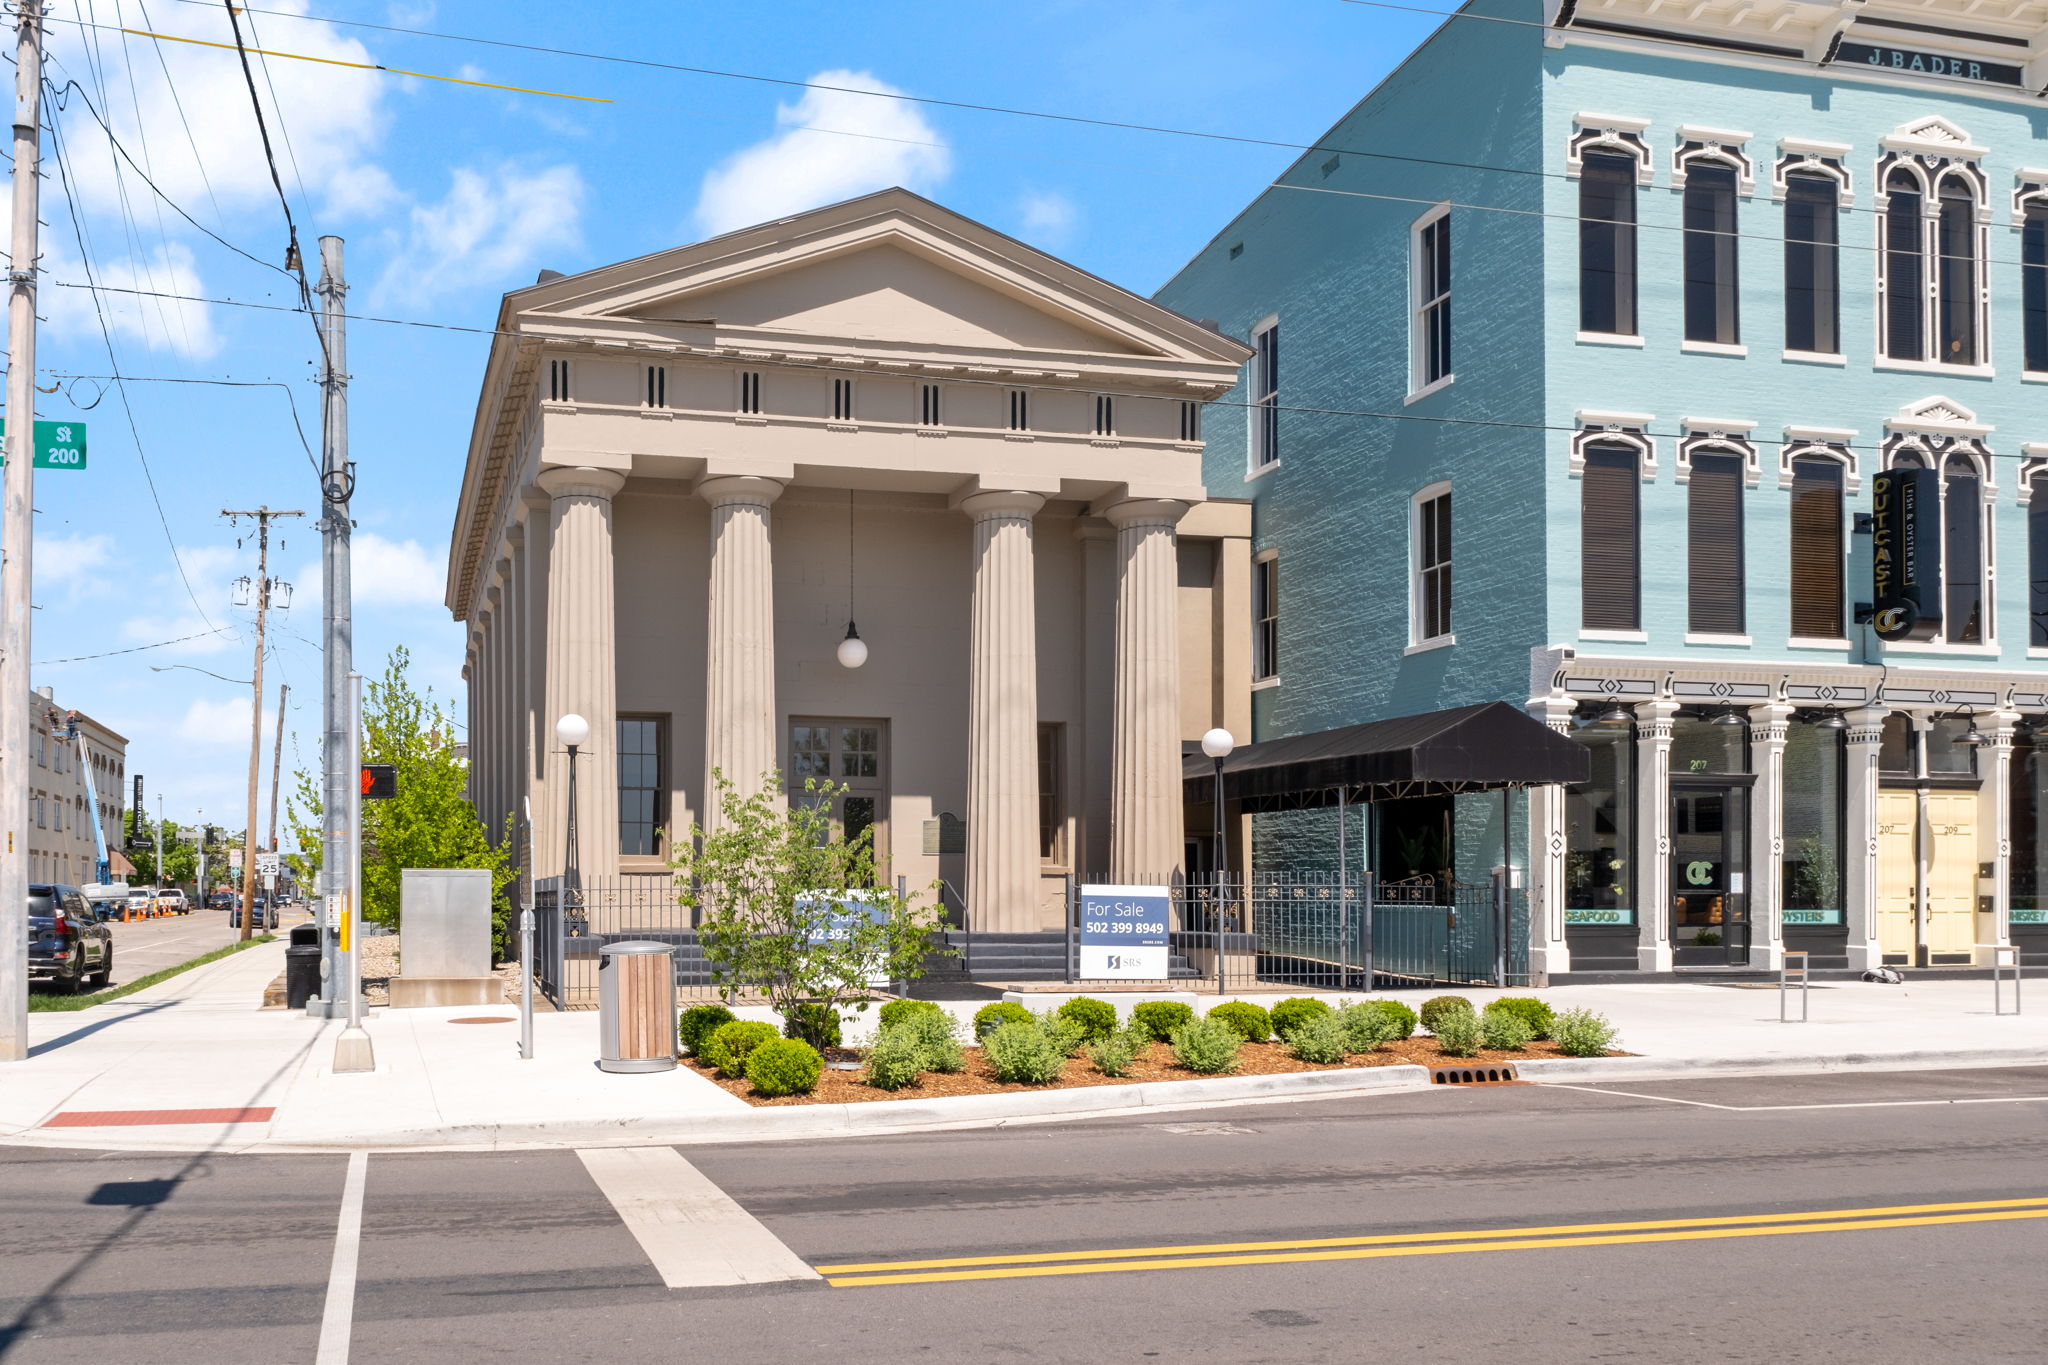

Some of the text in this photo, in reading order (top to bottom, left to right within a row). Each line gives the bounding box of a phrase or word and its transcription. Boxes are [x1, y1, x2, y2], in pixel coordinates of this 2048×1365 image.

[56, 426, 72, 443] St
[48, 447, 79, 464] 200
[1906, 488, 1914, 510] FISH
[1873, 477, 1893, 599] OUTCAST
[1906, 523, 1914, 558] OYSTER
[1690, 760, 1708, 771] 207
[1879, 825, 1894, 834] 207
[1944, 826, 1959, 834] 209
[262, 864, 277, 873] 25
[1087, 902, 1144, 917] For Sale
[1565, 910, 1620, 922] SEAFOOD
[1086, 922, 1164, 934] 502 399 8949
[1123, 958, 1142, 967] SRS
